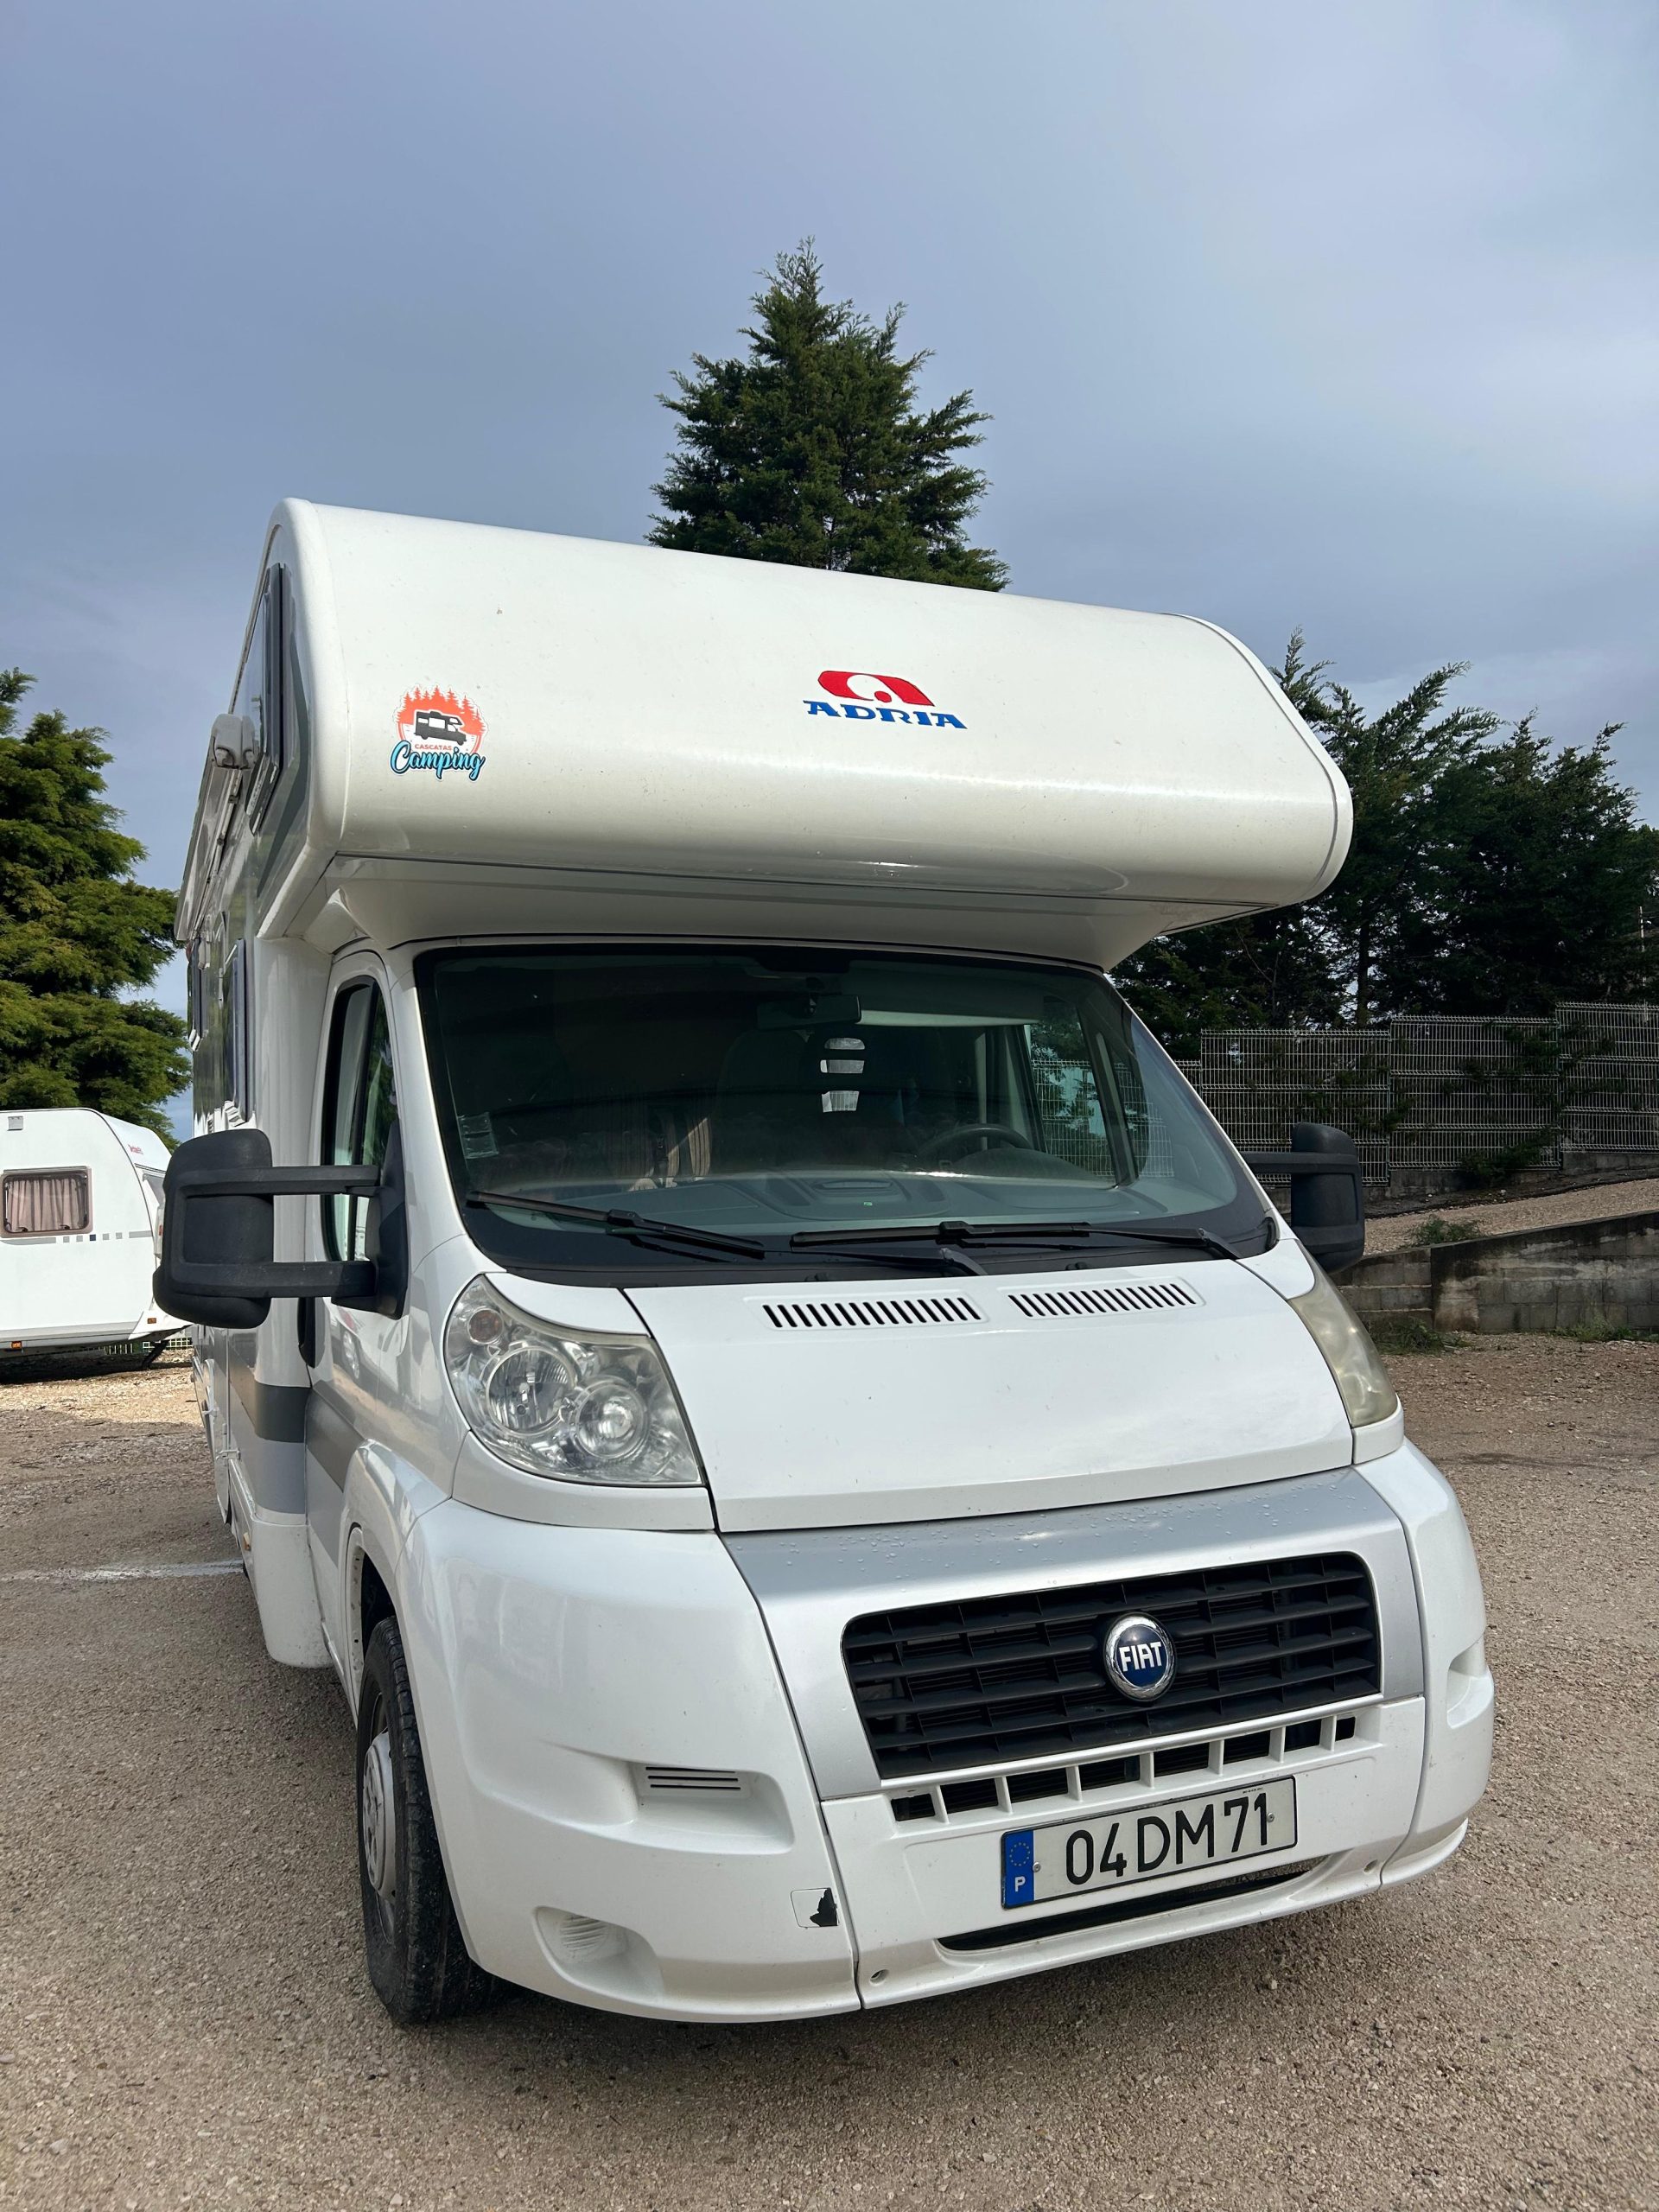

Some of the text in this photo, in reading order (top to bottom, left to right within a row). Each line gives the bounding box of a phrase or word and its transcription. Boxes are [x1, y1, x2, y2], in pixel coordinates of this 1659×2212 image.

[803, 700, 968, 729] ADRIA
[391, 740, 486, 781] Camping
[1119, 1642, 1162, 1672] FIAT
[1014, 1876, 1027, 1892] P
